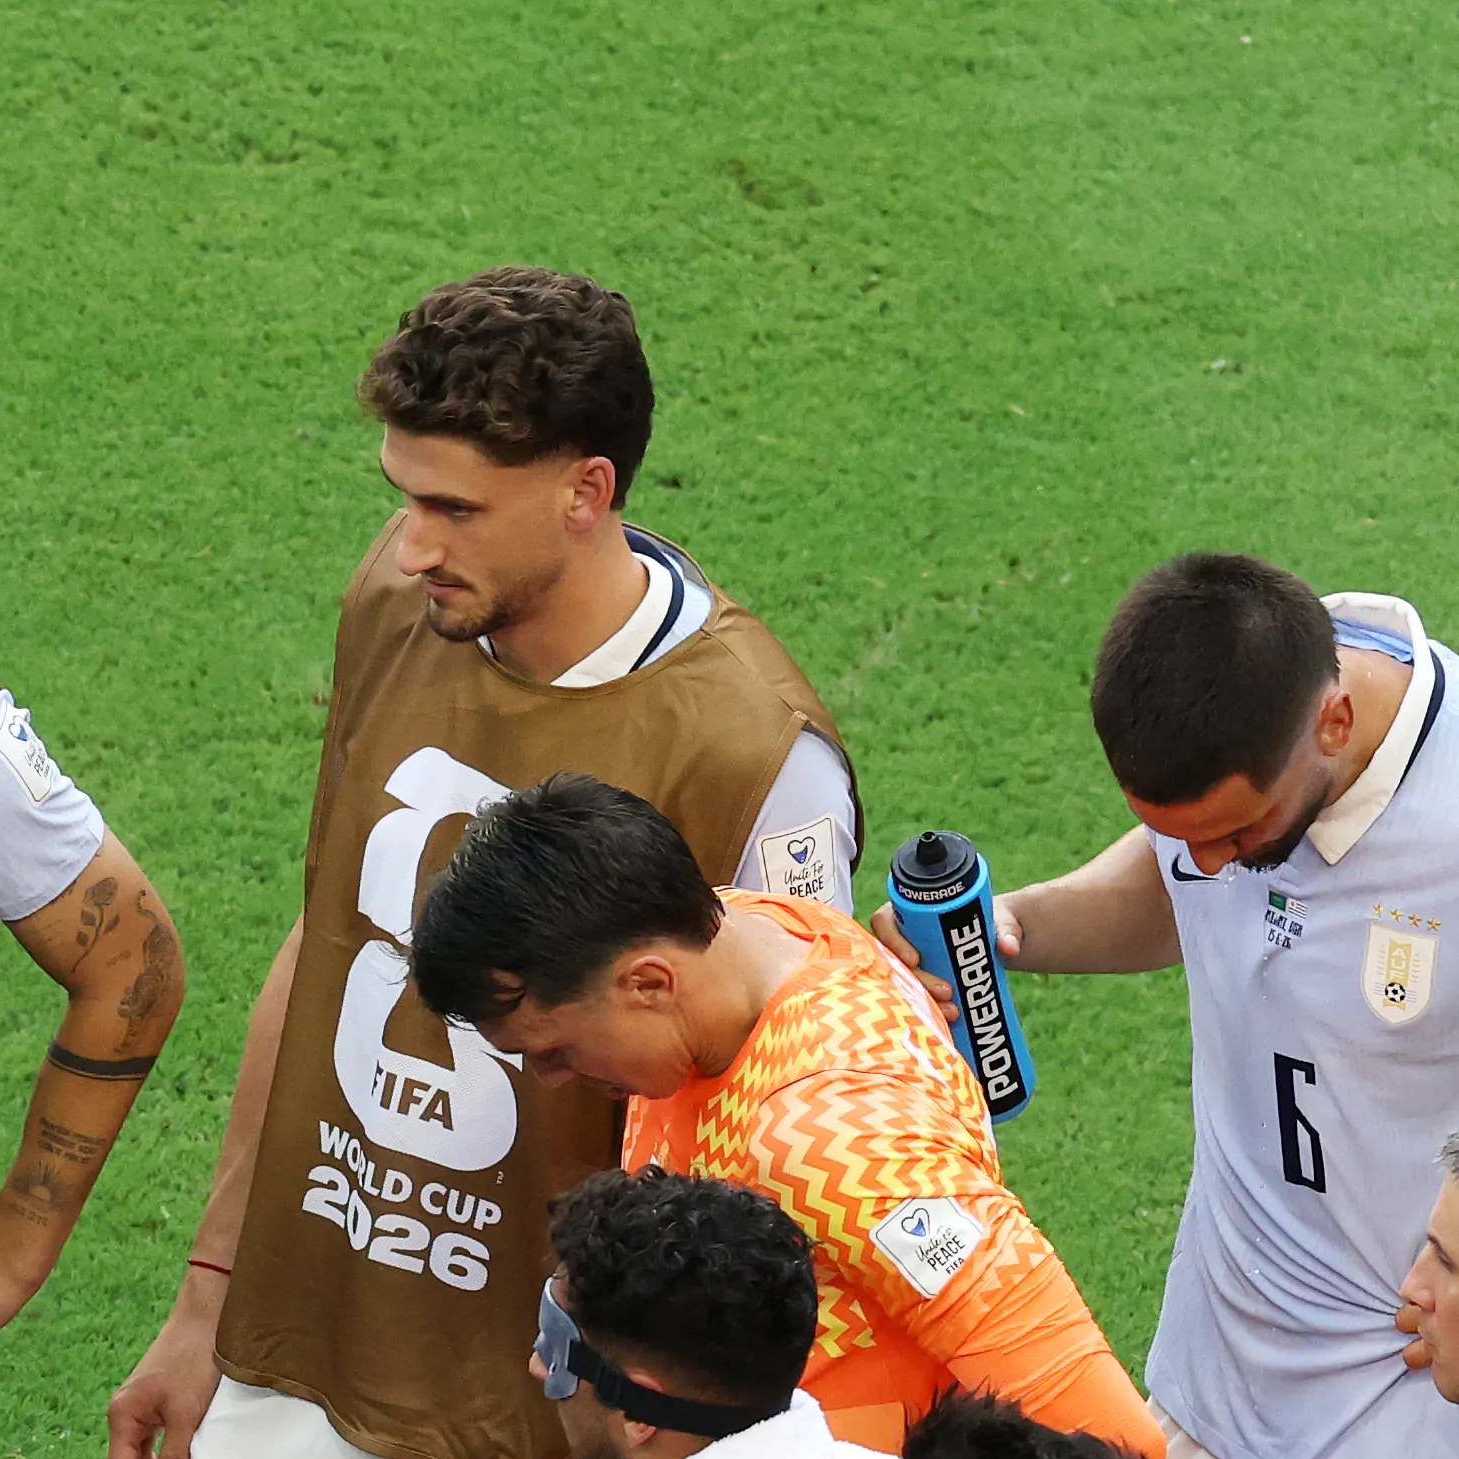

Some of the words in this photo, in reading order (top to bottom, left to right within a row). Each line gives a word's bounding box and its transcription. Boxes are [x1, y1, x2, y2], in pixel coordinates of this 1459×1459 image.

[789, 875, 824, 897] PEACE
[898, 880, 966, 901] POWERADE
[950, 918, 1019, 1101] POWERADE
[319, 1119, 413, 1203] WORLD
[419, 1182, 503, 1231] CUP
[1269, 1052, 1323, 1194] 6
[301, 1165, 491, 1292] 2026
[927, 1234, 966, 1271] PEACE
